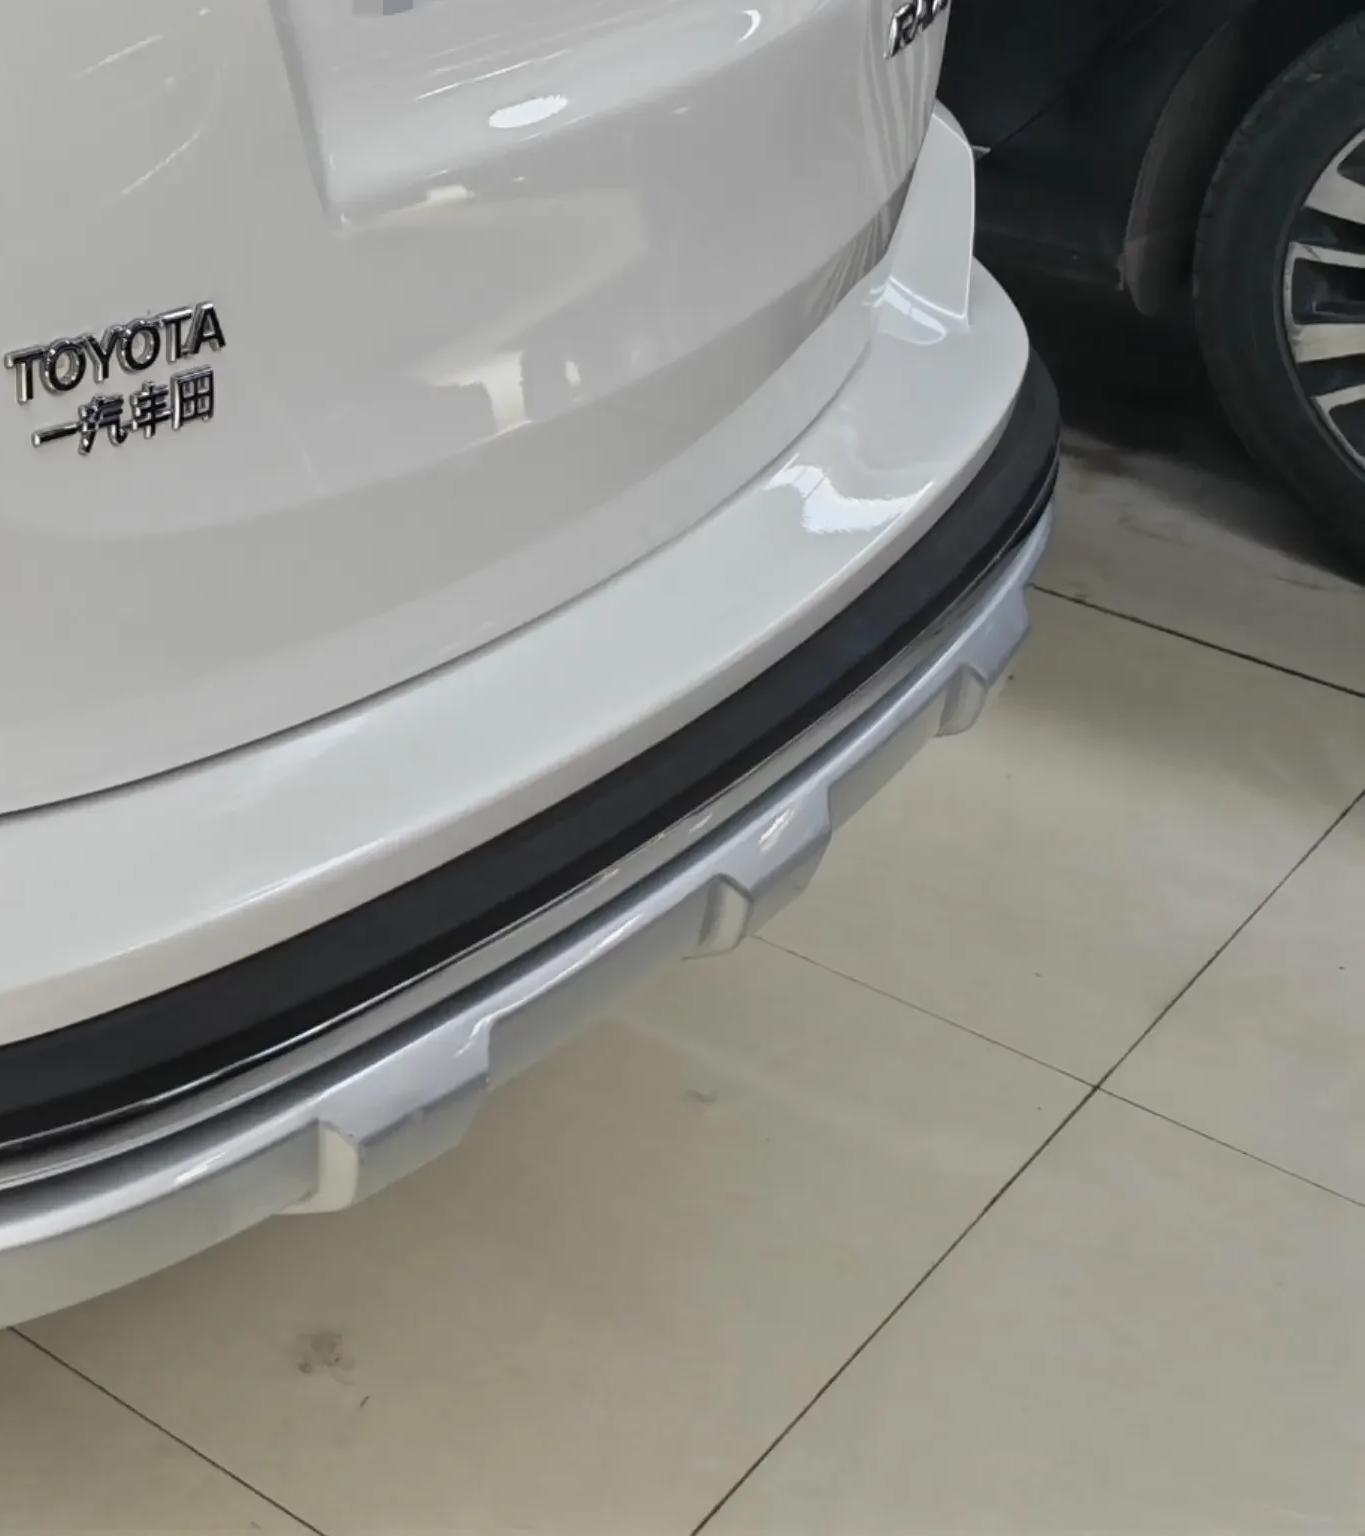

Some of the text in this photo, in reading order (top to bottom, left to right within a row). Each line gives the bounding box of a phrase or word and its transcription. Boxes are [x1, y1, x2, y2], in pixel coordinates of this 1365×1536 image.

[4, 301, 227, 405] TOYOTA
[31, 365, 215, 456] 一汽丰田
